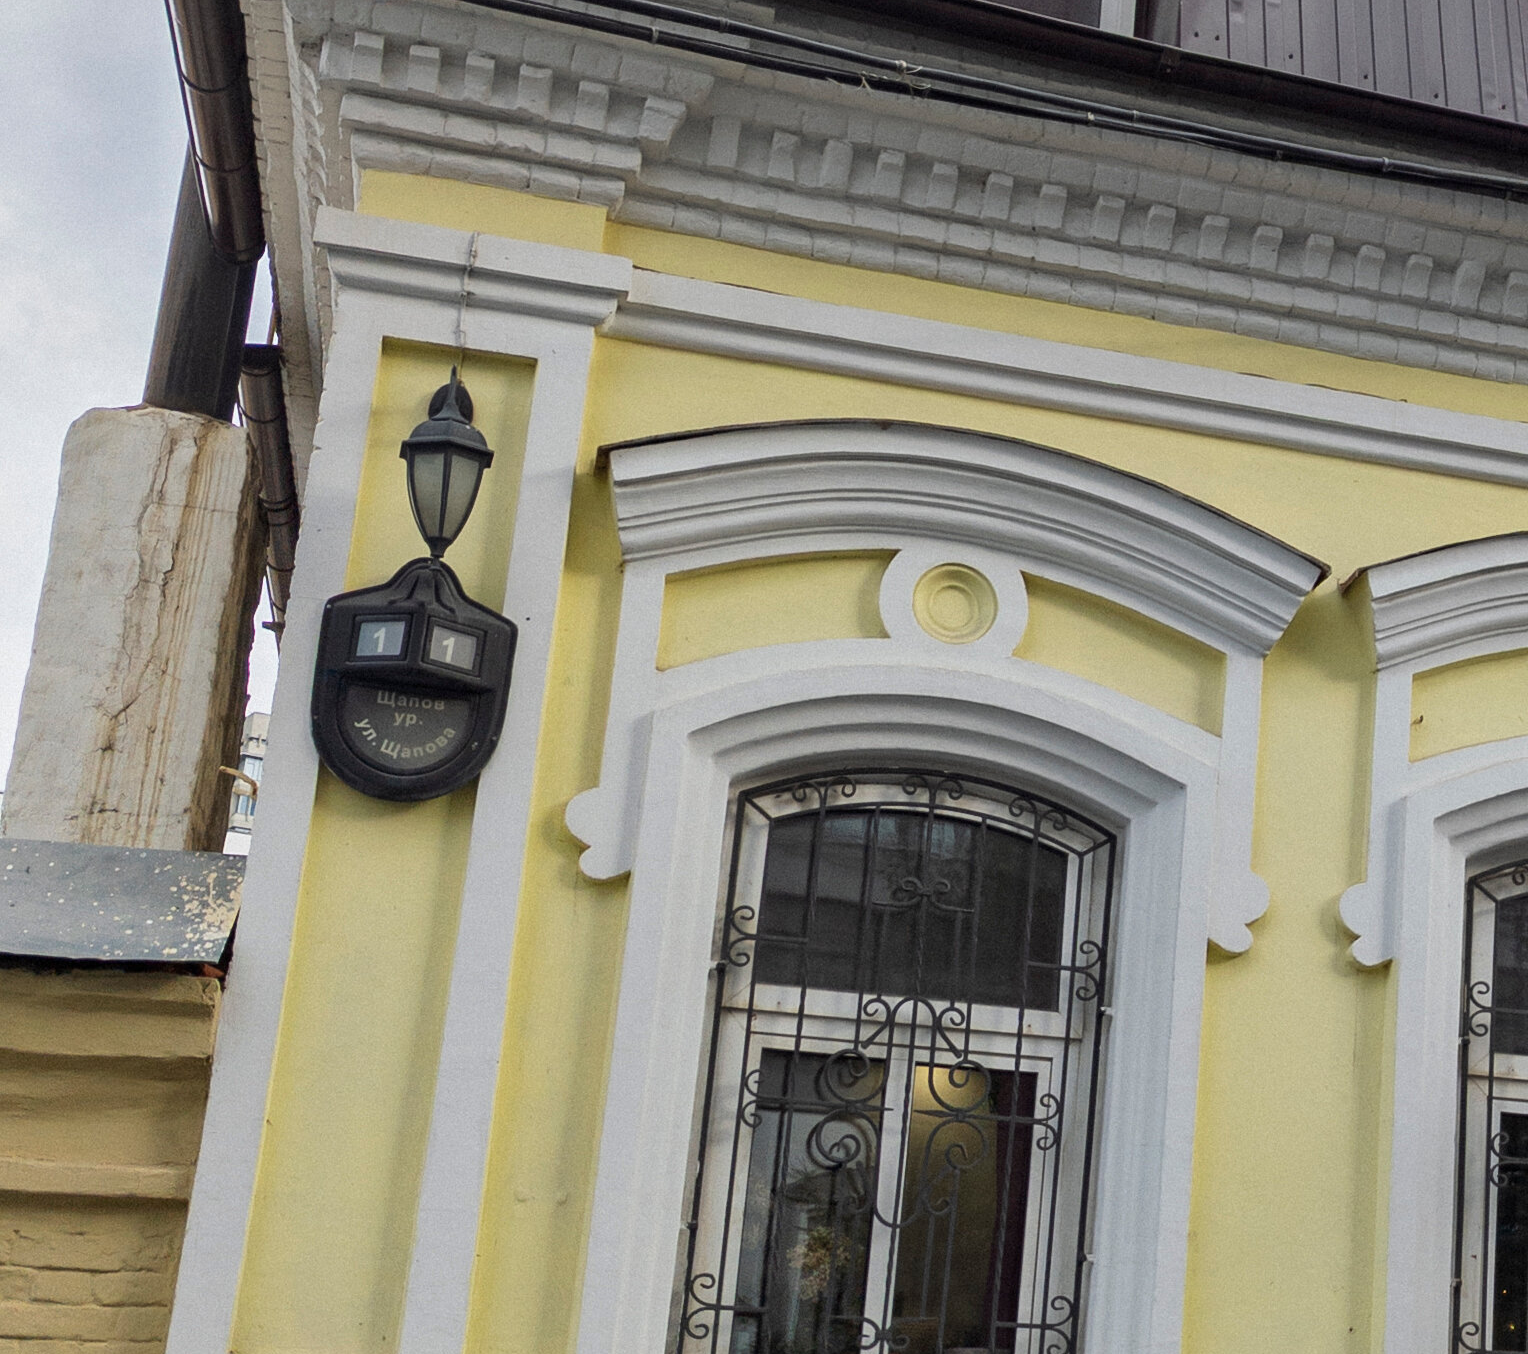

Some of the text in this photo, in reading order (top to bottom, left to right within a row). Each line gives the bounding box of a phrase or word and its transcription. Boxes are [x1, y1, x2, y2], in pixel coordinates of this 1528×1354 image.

[373, 627, 387, 653] 1
[441, 636, 457, 663] 1
[377, 690, 446, 711] Щапов
[393, 711, 424, 726] ур.
[354, 718, 457, 759] ул. Щапова
